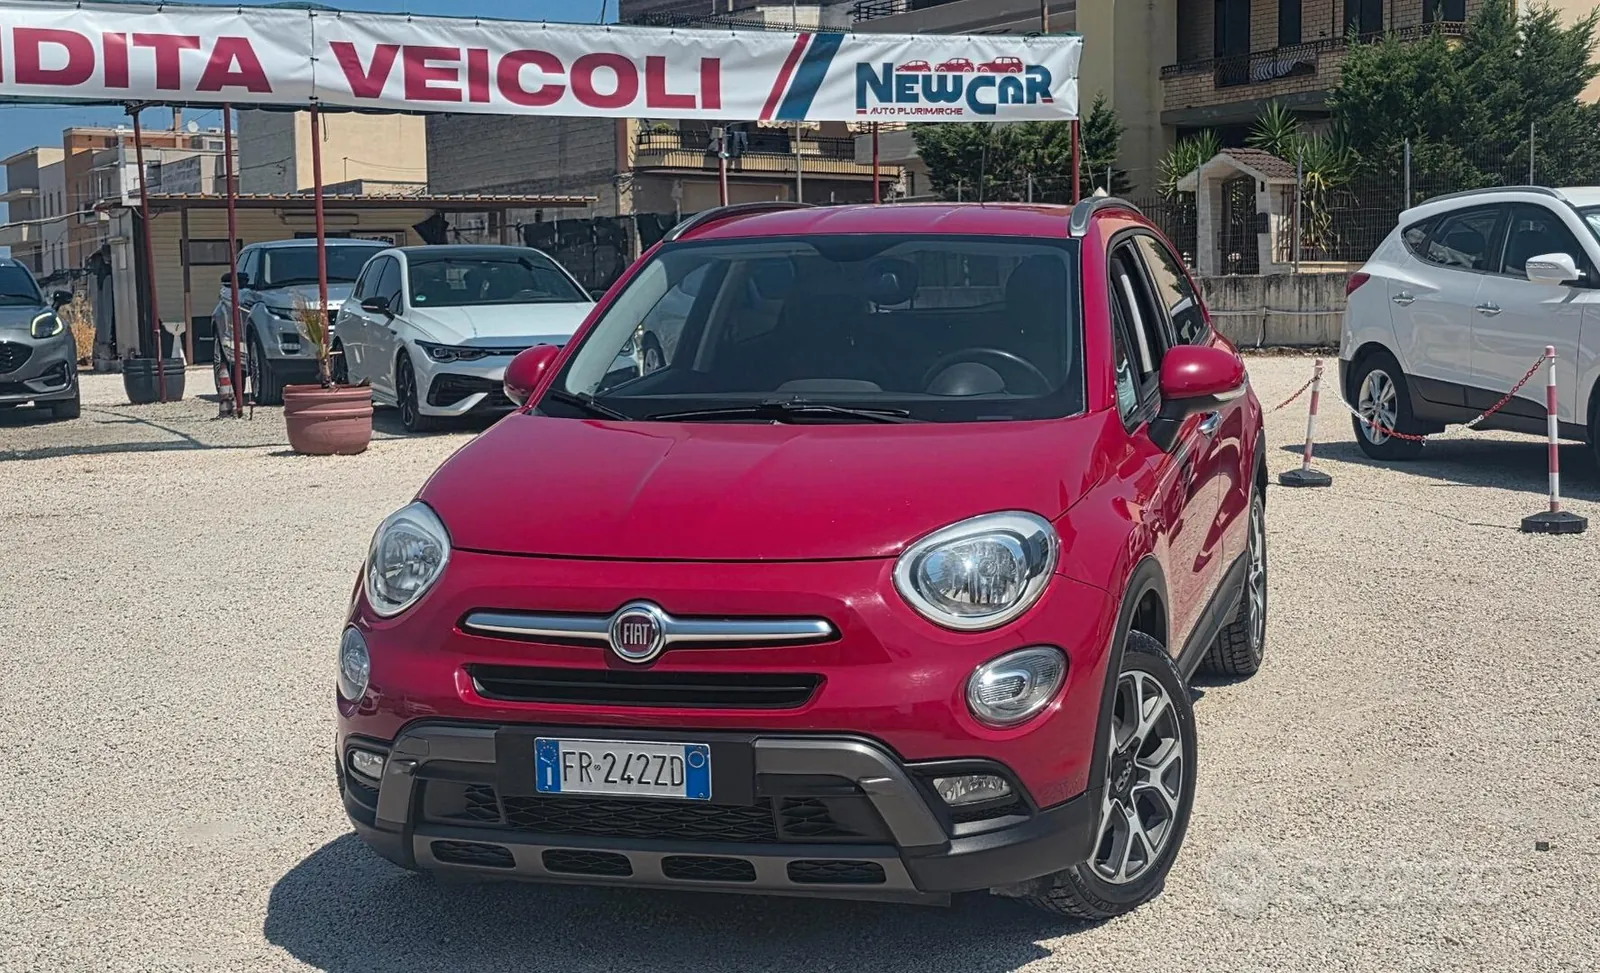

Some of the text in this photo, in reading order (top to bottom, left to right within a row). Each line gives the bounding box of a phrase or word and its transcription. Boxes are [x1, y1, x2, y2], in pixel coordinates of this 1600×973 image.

[0, 25, 721, 109] DITA VEICOLI
[870, 107, 963, 115] AUTO PLURIMARCHE
[624, 623, 649, 645] FIAT
